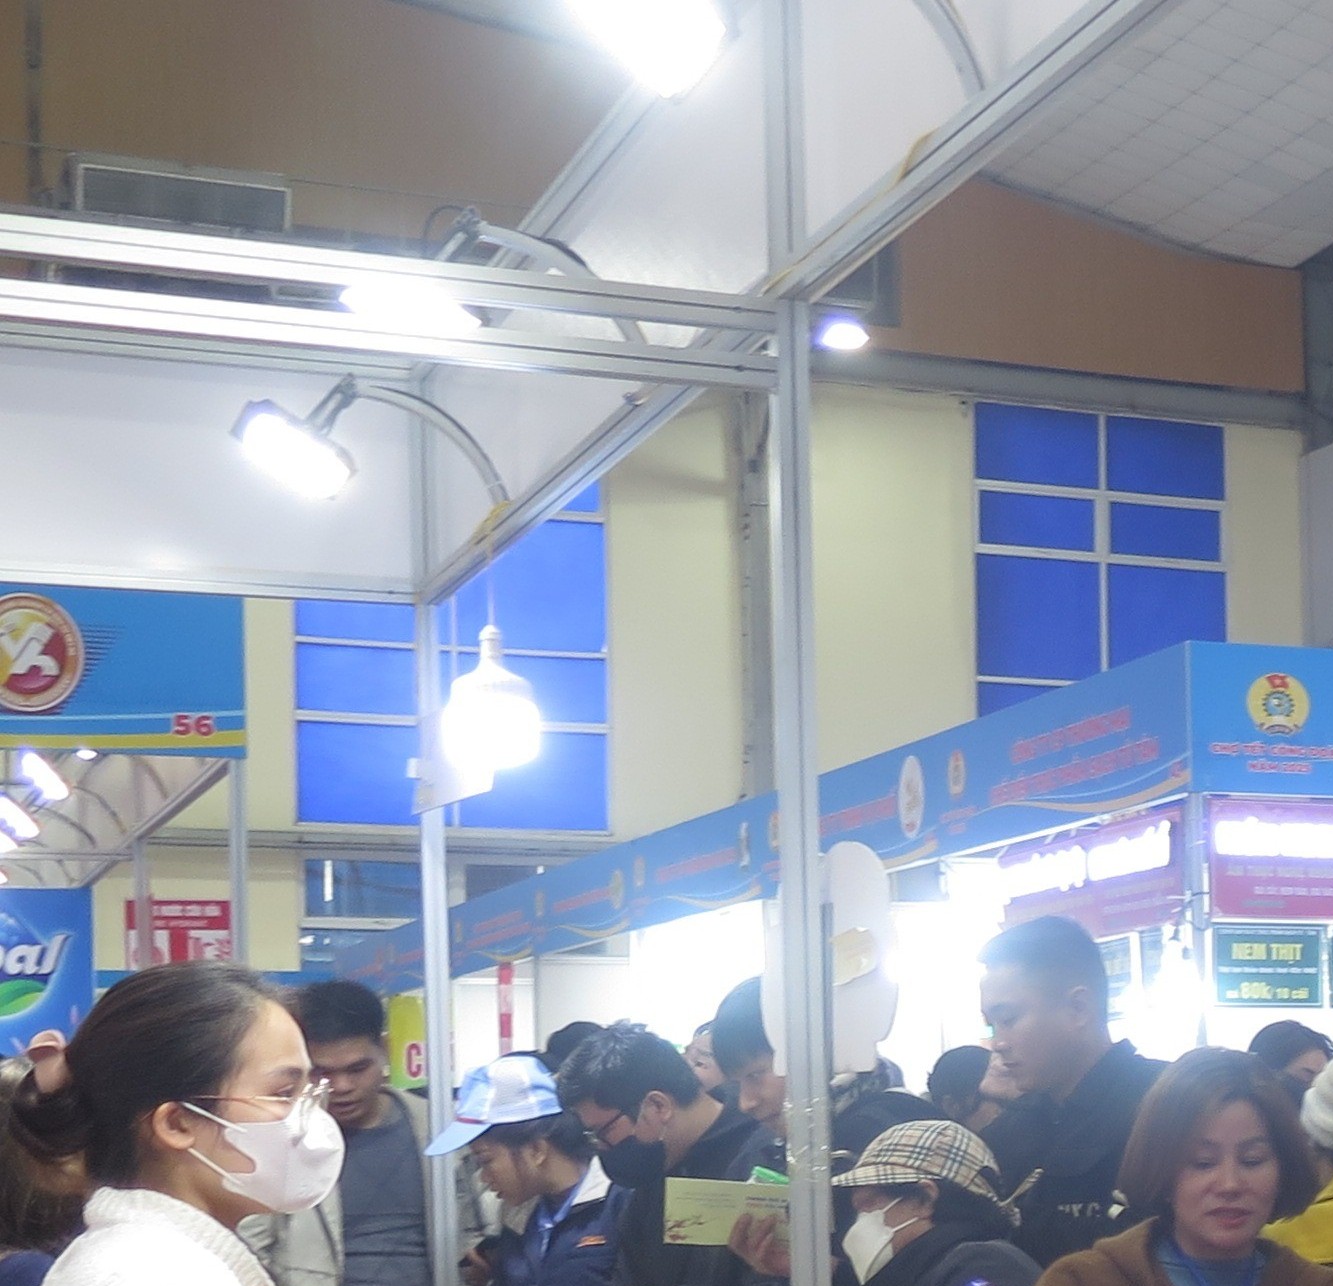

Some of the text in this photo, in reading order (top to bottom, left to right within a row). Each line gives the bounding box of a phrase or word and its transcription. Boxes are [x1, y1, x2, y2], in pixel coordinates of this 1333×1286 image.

[171, 713, 216, 738] 56
[1231, 943, 1303, 964] NEM THỊT
